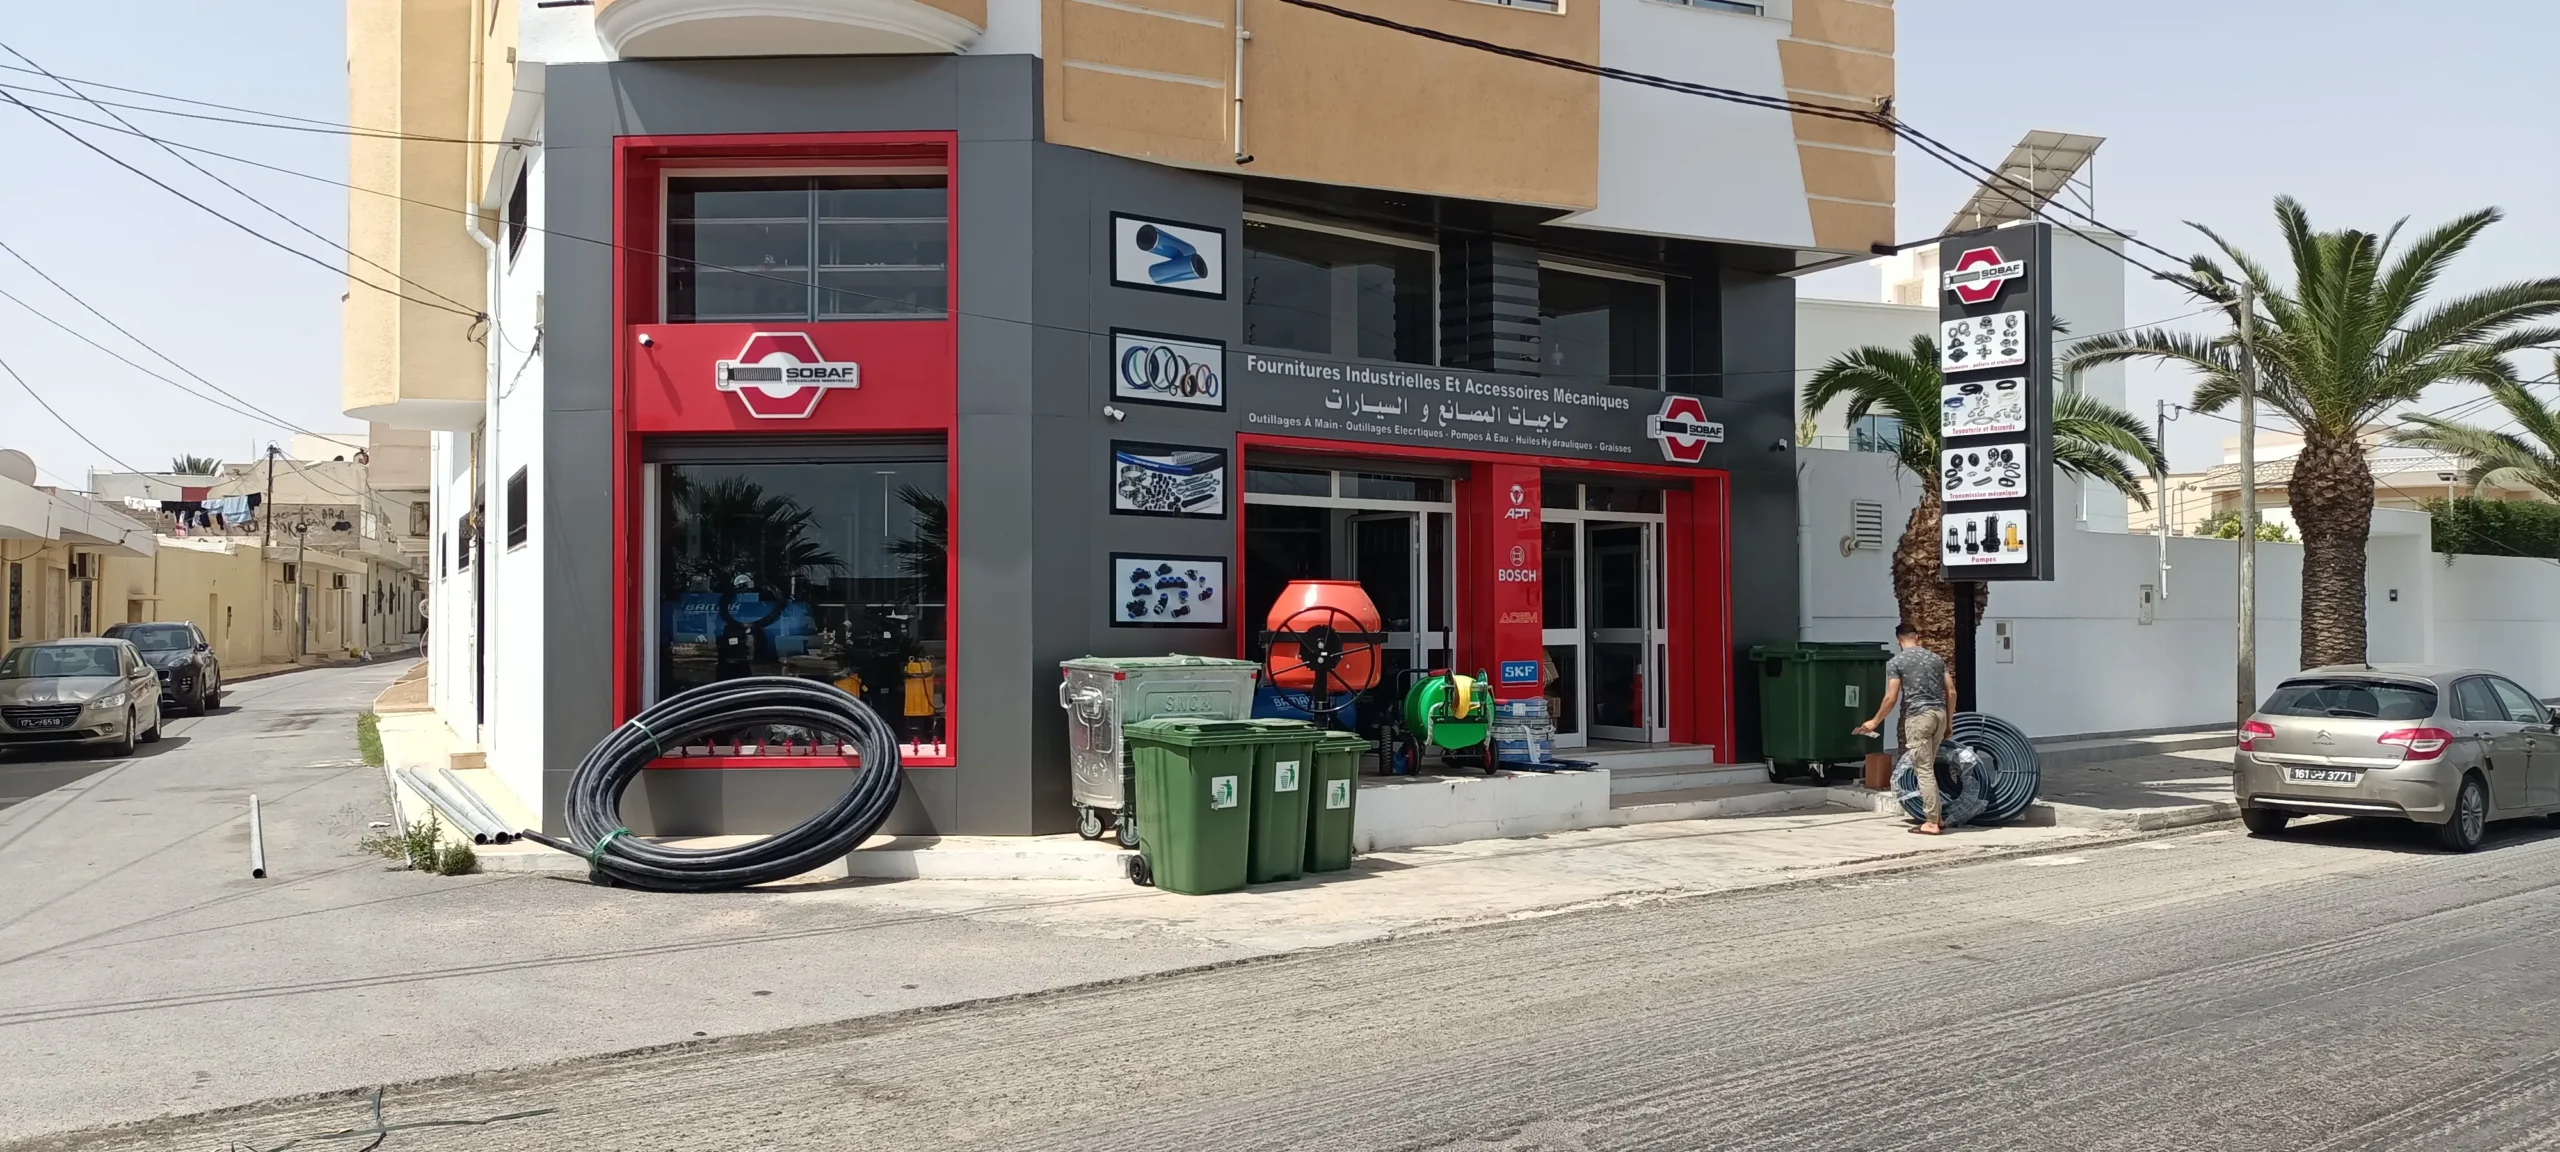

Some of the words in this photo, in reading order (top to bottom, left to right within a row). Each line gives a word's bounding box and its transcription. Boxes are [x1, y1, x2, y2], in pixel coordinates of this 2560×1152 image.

[1981, 264, 2020, 277] SOBAF
[786, 367, 854, 379] SOBAF
[1247, 354, 1341, 381] Fournitures
[1346, 365, 1441, 391] Industrielles
[1445, 376, 1461, 393] Et
[1465, 378, 1549, 401] Accessoires
[1553, 387, 1630, 411] Mécaniques
[1325, 388, 1408, 420] السيارات
[1420, 403, 1430, 423] و
[1438, 399, 1501, 428] المصانع
[1508, 405, 1569, 433] حاجيات
[1248, 412, 1301, 428] Outillages
[1346, 421, 1392, 436] Outillages
[1394, 424, 1444, 439] Elecrtiques
[1451, 429, 1484, 442] Pompes
[1493, 432, 1509, 443] Eau
[1515, 435, 1541, 446] Huiles
[1599, 441, 1632, 454] Graisses
[1689, 424, 1723, 436] SOBAF
[1949, 491, 1987, 499] Transmission
[1987, 490, 2019, 498] mécanique
[1504, 508, 1531, 520] APT
[1971, 556, 1997, 564] Pompes
[1498, 569, 1537, 582] BOSCH
[1504, 665, 1536, 678] SKF
[1164, 694, 1213, 712] SNCM
[2294, 769, 2309, 779] 161
[2327, 770, 2352, 782] 3771
